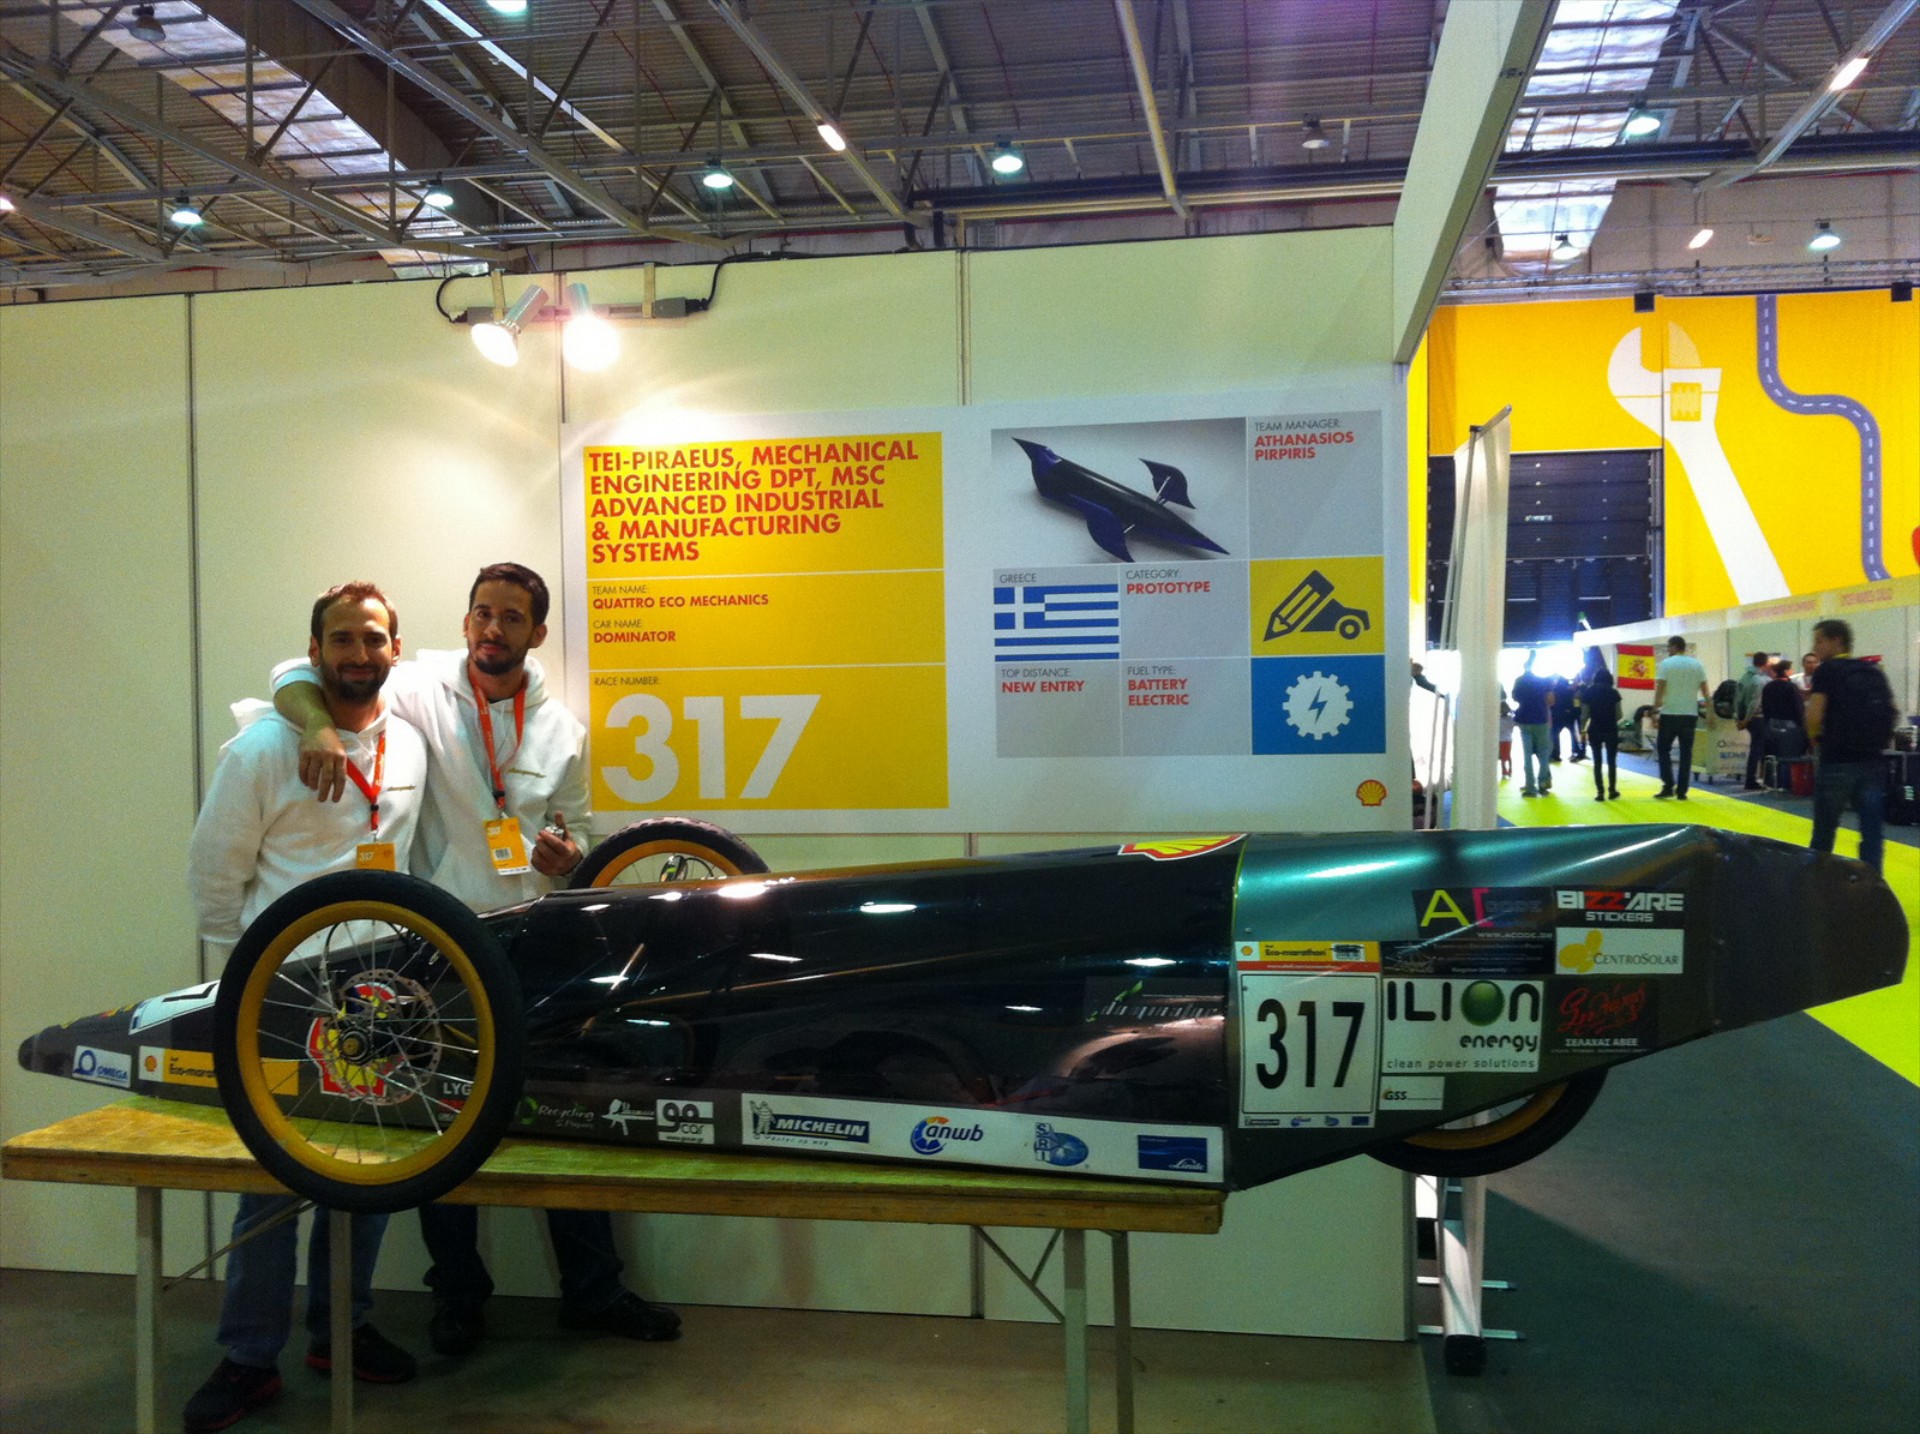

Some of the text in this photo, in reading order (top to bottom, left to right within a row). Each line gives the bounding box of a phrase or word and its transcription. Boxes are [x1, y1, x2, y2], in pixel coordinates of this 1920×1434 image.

[1255, 422, 1282, 431] TEAM
[1255, 431, 1354, 447] ATHANASIOS
[589, 440, 918, 472] TEI-PIRAEUS, MECHANICAL
[1255, 447, 1316, 461] PIRPIRIS
[590, 465, 885, 494] ENGINEERING DPT, MSC
[590, 489, 883, 518] ADVANCED INDUSTRIAL
[592, 513, 841, 540] & MANUFACTURING
[592, 541, 699, 564] SYSTEMS
[1000, 573, 1037, 583] GREECE
[593, 585, 618, 595] TEAM
[1126, 581, 1211, 595] PROTOTYPE
[593, 594, 769, 610] QUATTRO ECO MECHANICS
[593, 619, 612, 629] CAR
[593, 631, 676, 644] DOMINATOR
[1001, 668, 1020, 678] TOP
[1127, 666, 1149, 676] FUEL
[594, 677, 618, 687] RACE
[1002, 680, 1085, 693] NEW ENTRY
[1128, 678, 1188, 691] BATTERY
[1128, 694, 1189, 706] ELECTRIC
[600, 693, 822, 804] 317
[1557, 890, 1684, 911] BIZZ'ARE
[1586, 911, 1654, 922] STICKERS
[1265, 946, 1327, 957] Eco-marathon
[1256, 998, 1365, 1089] 317
[1459, 1034, 1538, 1052] energy
[1387, 1057, 1535, 1070] clean power solutions
[97, 1065, 128, 1080] OMEGA
[538, 1104, 594, 1122] Recycling
[681, 1123, 704, 1135] car
[775, 1118, 865, 1137] MICHELIN
[927, 1123, 983, 1142] anwb
[1169, 1158, 1205, 1172] Linde
